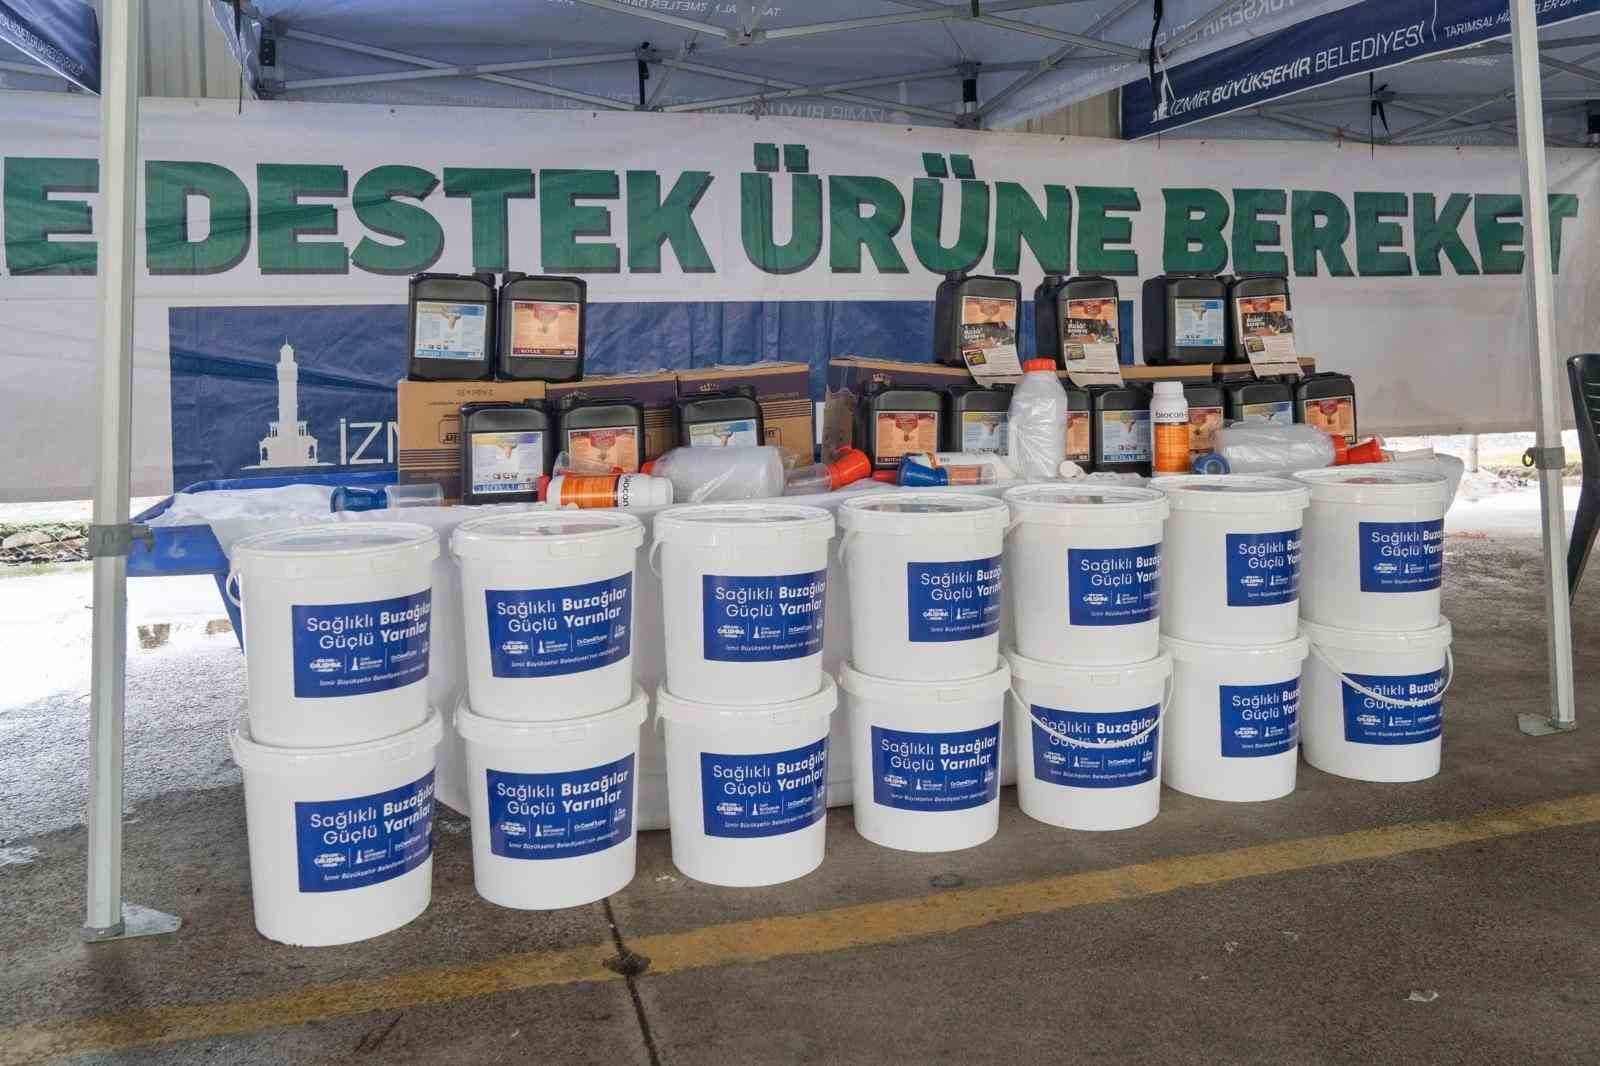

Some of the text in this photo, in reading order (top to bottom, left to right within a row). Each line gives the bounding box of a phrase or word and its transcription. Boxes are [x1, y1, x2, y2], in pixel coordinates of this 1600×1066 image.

[1443, 16, 1494, 38] TARIMSAL
[1169, 20, 1425, 117] İZMİR BÜYÜKŞEHİR BELEDİYESİ
[145, 160, 716, 276] DESTEK
[740, 143, 1140, 276] ÜRÜNE
[1162, 187, 1578, 276] BEREKET
[1372, 531, 1419, 545] Sağlıklı
[1239, 542, 1284, 557] Sağlıklı
[1381, 546, 1419, 557] Güçlü
[1081, 558, 1131, 573] Sağlıklı
[1248, 556, 1284, 569] Güçlü
[921, 571, 972, 588] Sağlıklı
[1092, 574, 1131, 587] Güçlü
[497, 588, 626, 619] Sağlıklı Buzağılar
[716, 587, 773, 603] Sağlıklı
[932, 588, 972, 602] Güçlü
[508, 607, 621, 633] Güçlü Yarınlar
[726, 600, 822, 620] Güçlü Yarınlar
[307, 614, 373, 634] Sağlıklı
[320, 622, 428, 650] Güçlü Yarınlar
[1233, 693, 1279, 708] Sağlıklı
[1242, 708, 1279, 720] Güçlü
[881, 736, 996, 756] Sağlıklı Buzağılar
[891, 753, 991, 771] Güçlü Yarınlar
[713, 764, 770, 781] Sağlıklı
[497, 770, 628, 801] Sağlıklı Buzağılar
[724, 769, 823, 797] Güçlü Yarınlar
[508, 789, 621, 818] Güçlü Yarınlar
[311, 808, 376, 829] Sağlıklı
[323, 804, 430, 844] Güçlü Yarınlar
